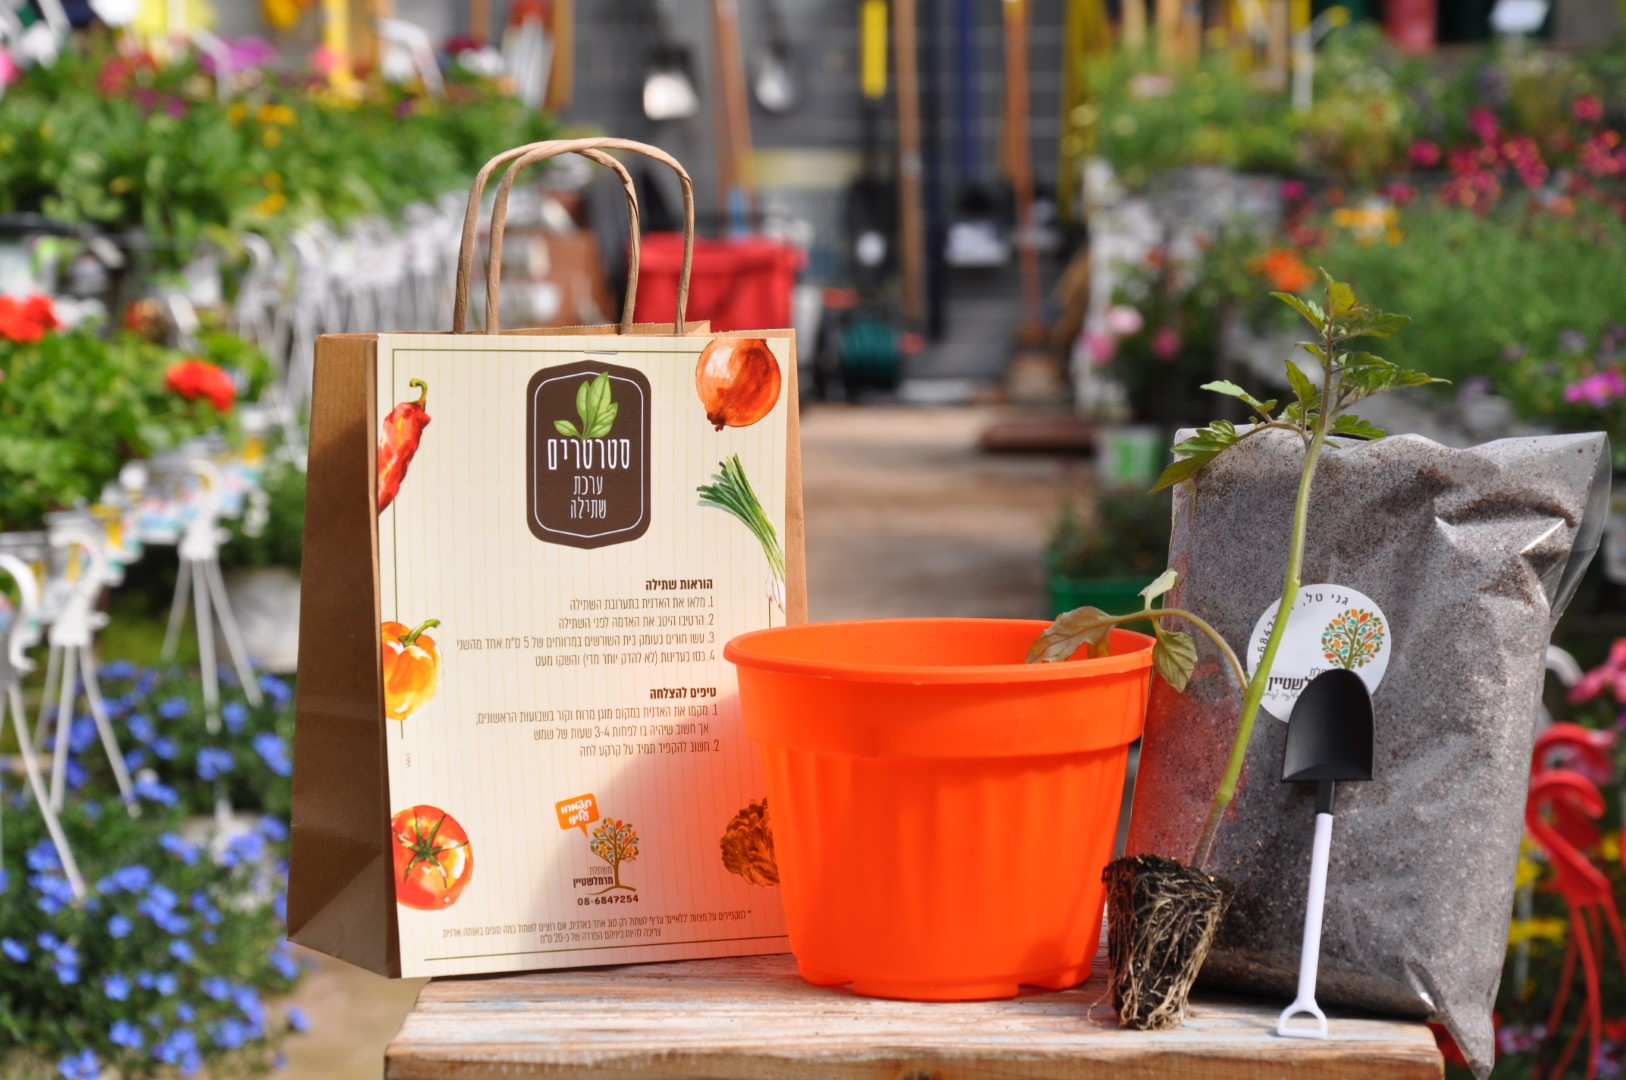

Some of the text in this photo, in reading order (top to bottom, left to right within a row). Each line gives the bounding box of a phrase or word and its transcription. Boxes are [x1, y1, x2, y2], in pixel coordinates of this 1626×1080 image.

[547, 438, 630, 470] סטרטרים
[573, 475, 604, 495] ערכת
[570, 497, 607, 519] שתילה
[645, 579, 713, 591] הוראות שתילה
[570, 598, 601, 611] השתילה
[604, 598, 640, 610] בתערובת
[642, 597, 670, 609] האדנית
[672, 597, 685, 608] את
[687, 596, 706, 608] מלאו
[1331, 593, 1349, 606] גני
[558, 617, 591, 629] השתילה
[593, 616, 609, 628] לפני
[611, 616, 640, 627] האדמה
[642, 616, 655, 627] את
[657, 615, 676, 627] היטב
[679, 615, 704, 627] הרטיבו
[456, 638, 482, 651] מהשני
[485, 638, 503, 650] אחד
[523, 636, 530, 649] 5
[531, 636, 544, 649] של
[546, 636, 582, 648] במרווחים
[584, 635, 620, 647] השורשים
[622, 634, 636, 646] בית
[666, 634, 688, 645] חורים
[689, 633, 705, 644] עשו
[535, 655, 553, 667] מעט
[555, 654, 580, 667] והשקו
[602, 653, 618, 664] יותר
[621, 652, 641, 665] להדק
[661, 651, 690, 662] בעדינות
[693, 651, 705, 662] כסו
[649, 686, 717, 700] טיפים להצלחה
[520, 710, 554, 723] בשבועות
[557, 709, 573, 723] וקור
[575, 709, 595, 720] מרוח
[598, 708, 613, 721] מוגן
[615, 707, 641, 720] במקום
[643, 706, 671, 718] האדנית
[673, 706, 686, 717] את
[688, 705, 708, 717] מקמו
[534, 729, 554, 741] שמש
[556, 727, 568, 740] של
[571, 727, 592, 739] שעות
[612, 725, 637, 737] לפחות
[649, 724, 674, 736] שיהיה
[676, 723, 696, 735] חשוב
[698, 723, 709, 735] אך
[579, 745, 596, 757] לחה
[599, 744, 621, 757] קרקע
[623, 743, 634, 756] על
[637, 743, 656, 754] תמיד
[658, 741, 687, 756] להקפיד
[690, 741, 710, 753] חשוב
[589, 865, 613, 876] משתלת
[573, 876, 613, 888] מרמלשטיין
